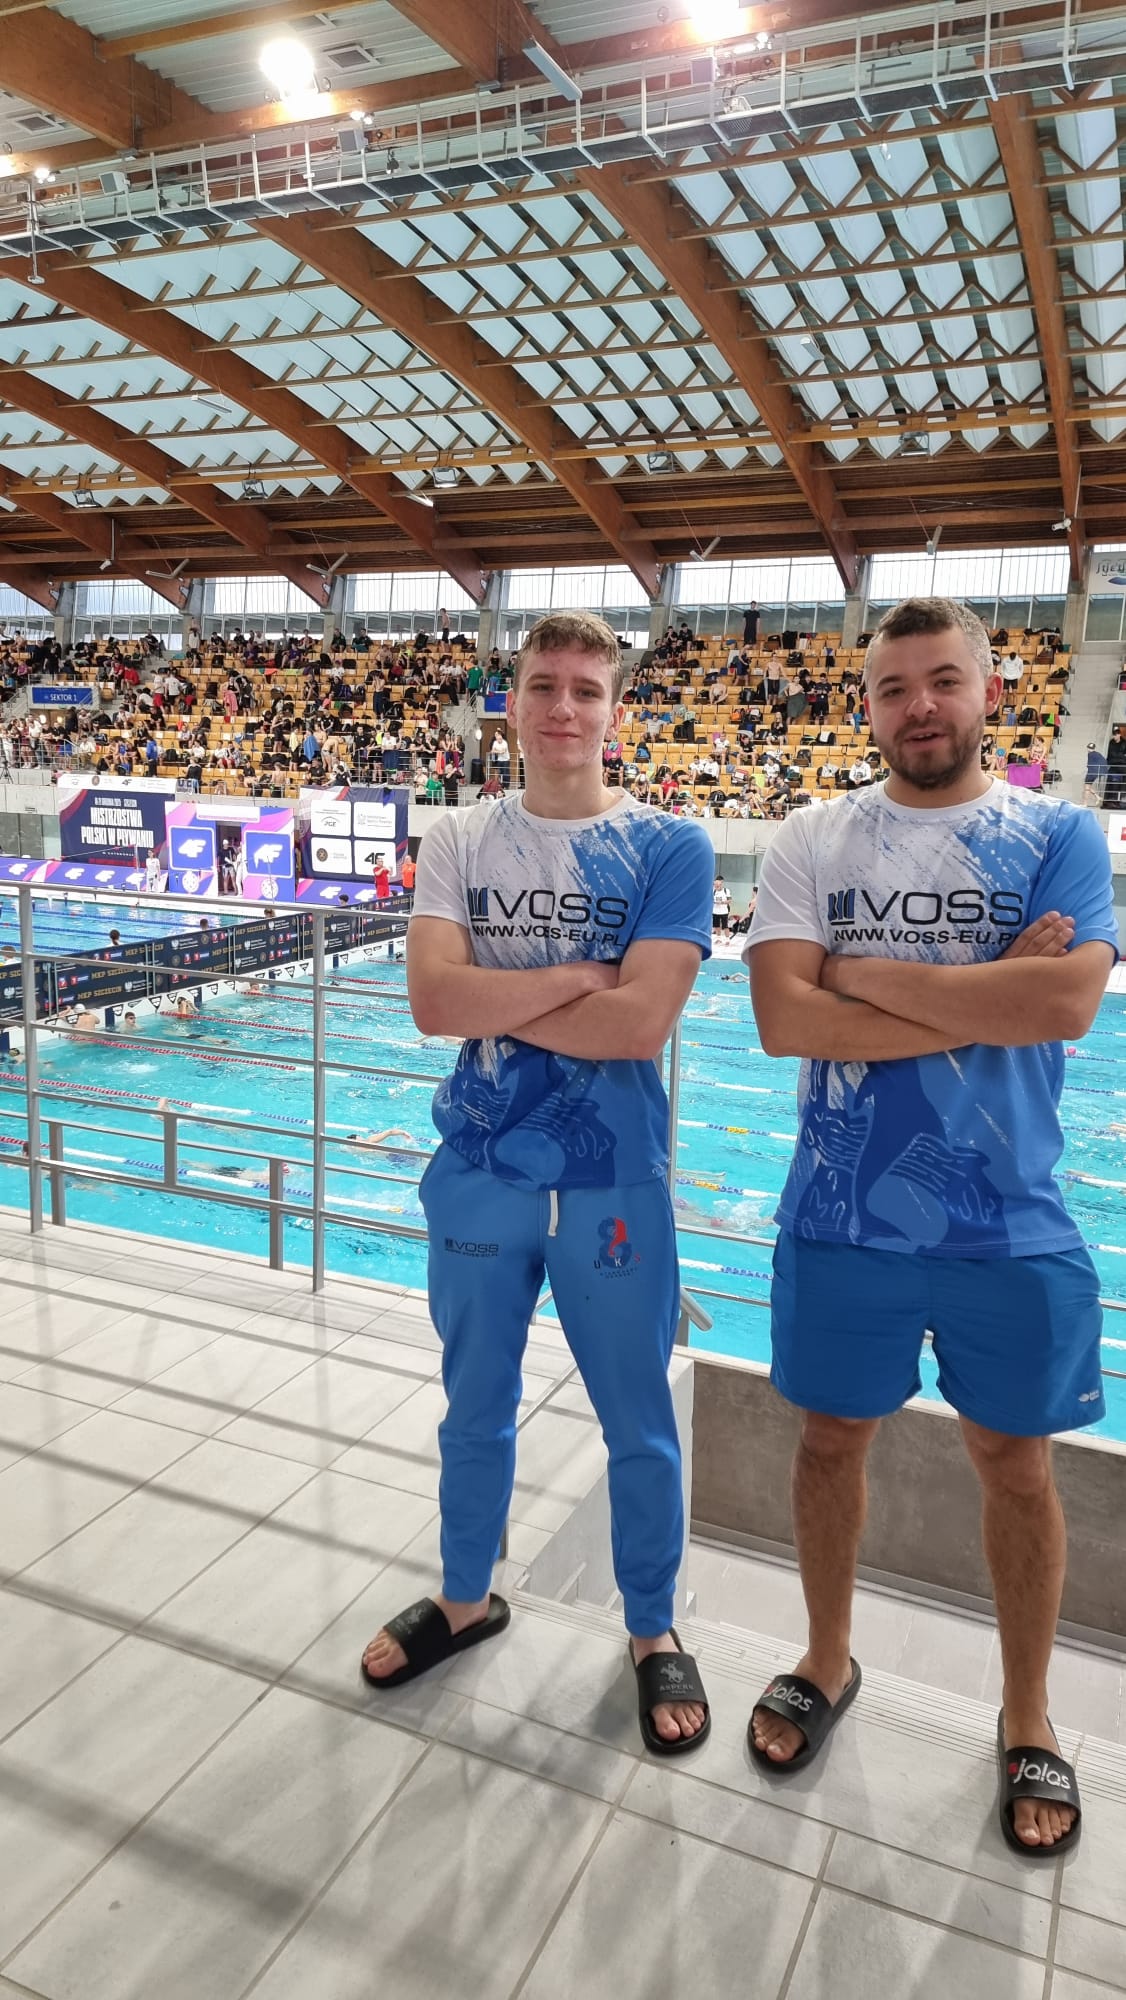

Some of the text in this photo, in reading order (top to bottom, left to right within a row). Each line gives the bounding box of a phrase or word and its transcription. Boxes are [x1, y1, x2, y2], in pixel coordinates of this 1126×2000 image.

[50, 693, 72, 702] SEKTOR
[90, 807, 143, 828] MISTRZOSTWA
[80, 826, 107, 845] POLSKI
[107, 827, 116, 846] W
[493, 889, 629, 929] VOSS
[861, 889, 1024, 927] VOSS
[455, 1240, 499, 1253] VOSS
[763, 1683, 813, 1711] jalas
[1013, 1758, 1071, 1789] jalas
